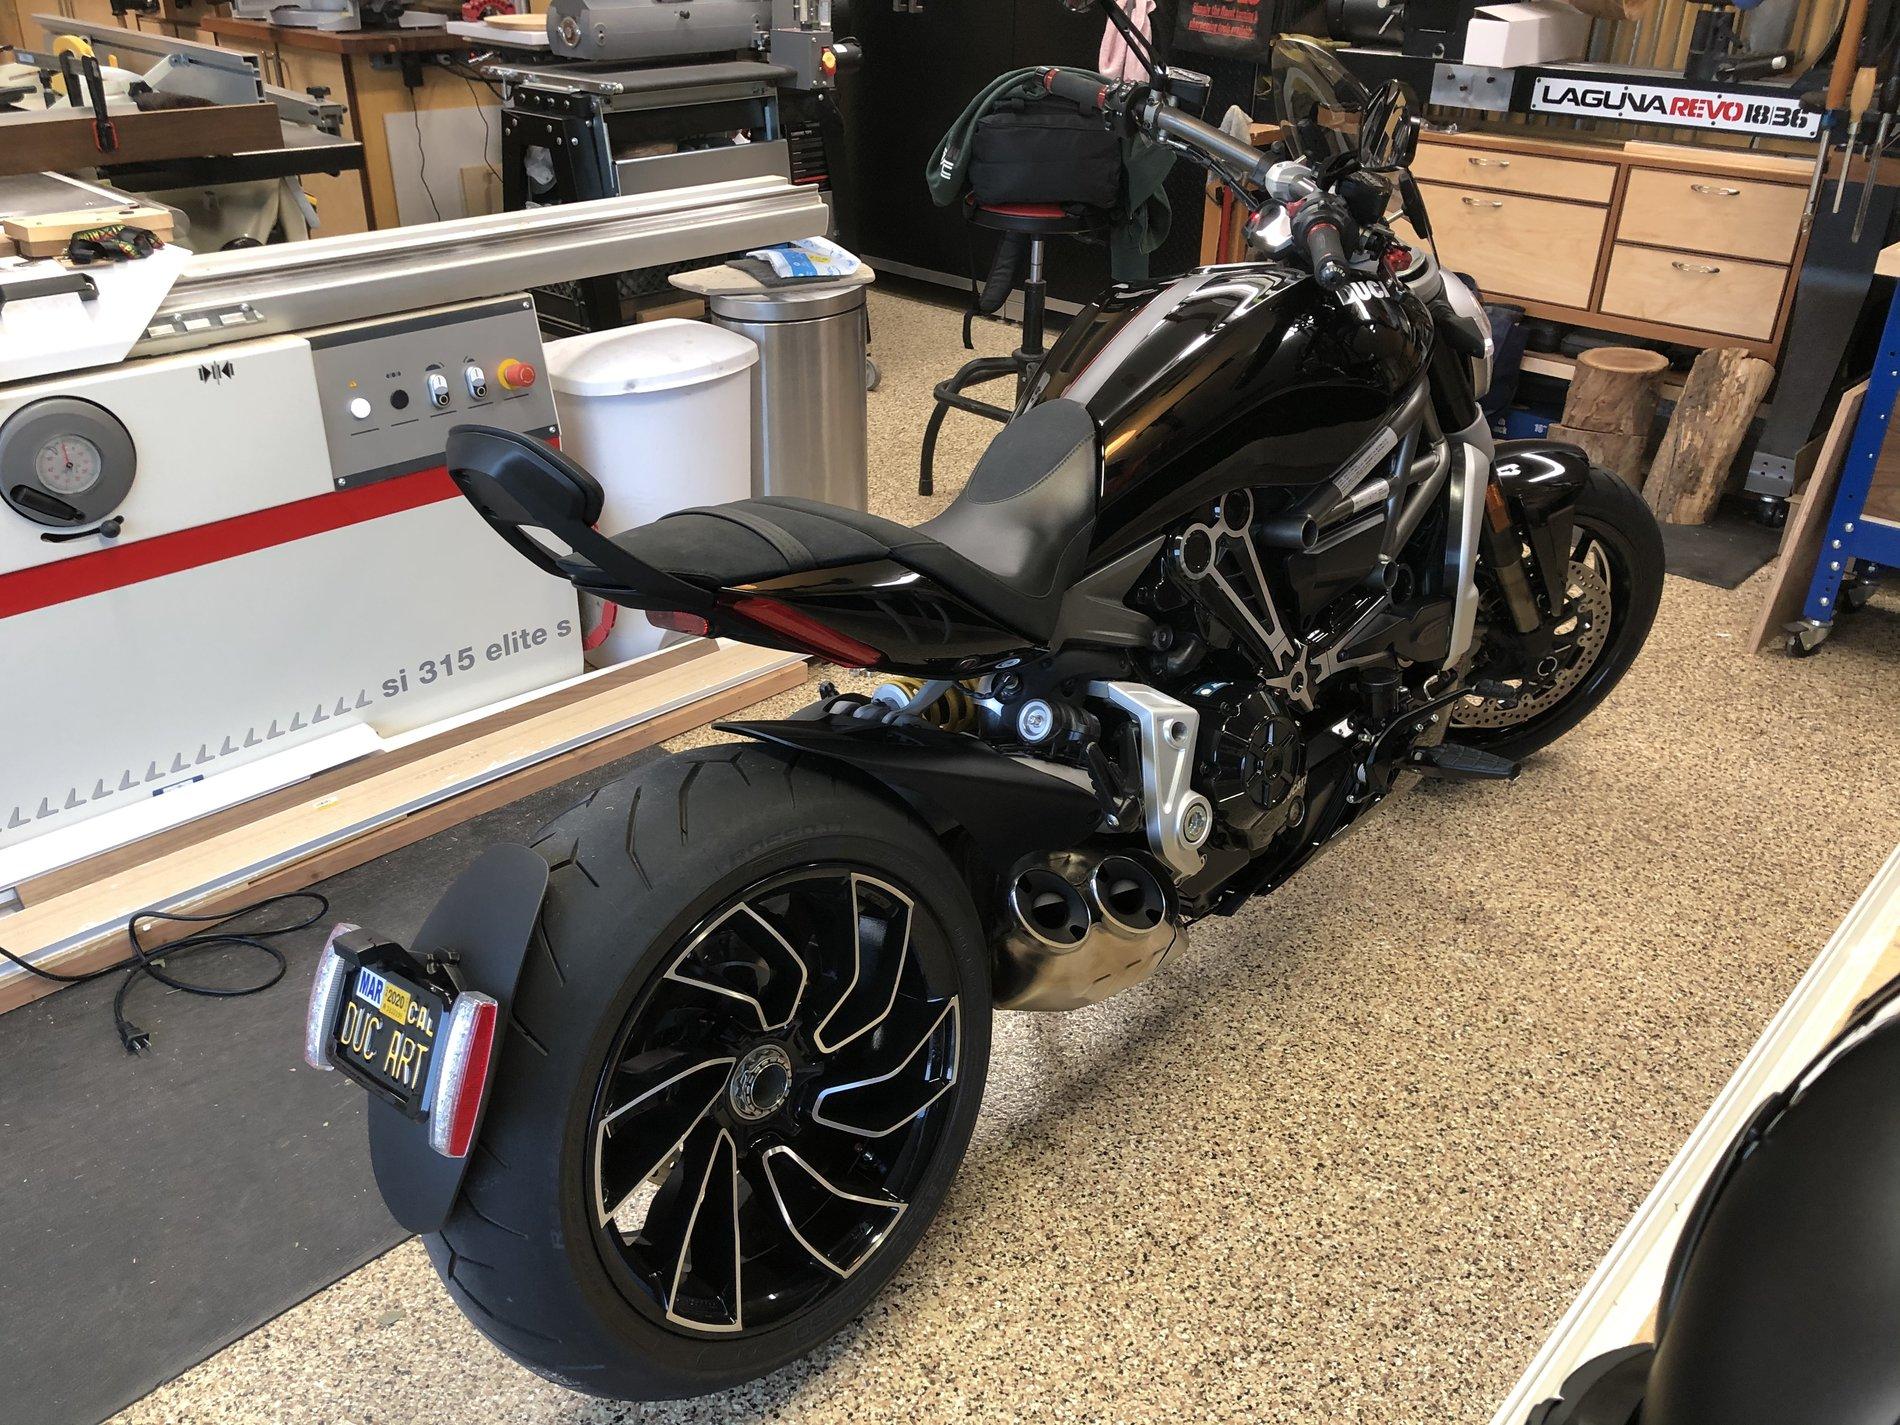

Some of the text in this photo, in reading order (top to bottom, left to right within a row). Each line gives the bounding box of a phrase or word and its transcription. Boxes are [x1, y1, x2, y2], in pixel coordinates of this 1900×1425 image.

[1542, 85, 1667, 115] LAGUNA
[1669, 96, 1743, 122] REVO
[381, 619, 572, 698] si 315 elite s
[359, 970, 405, 1010] MAR 2020
[341, 1001, 384, 1061] DUC
[384, 1030, 429, 1090] ART
